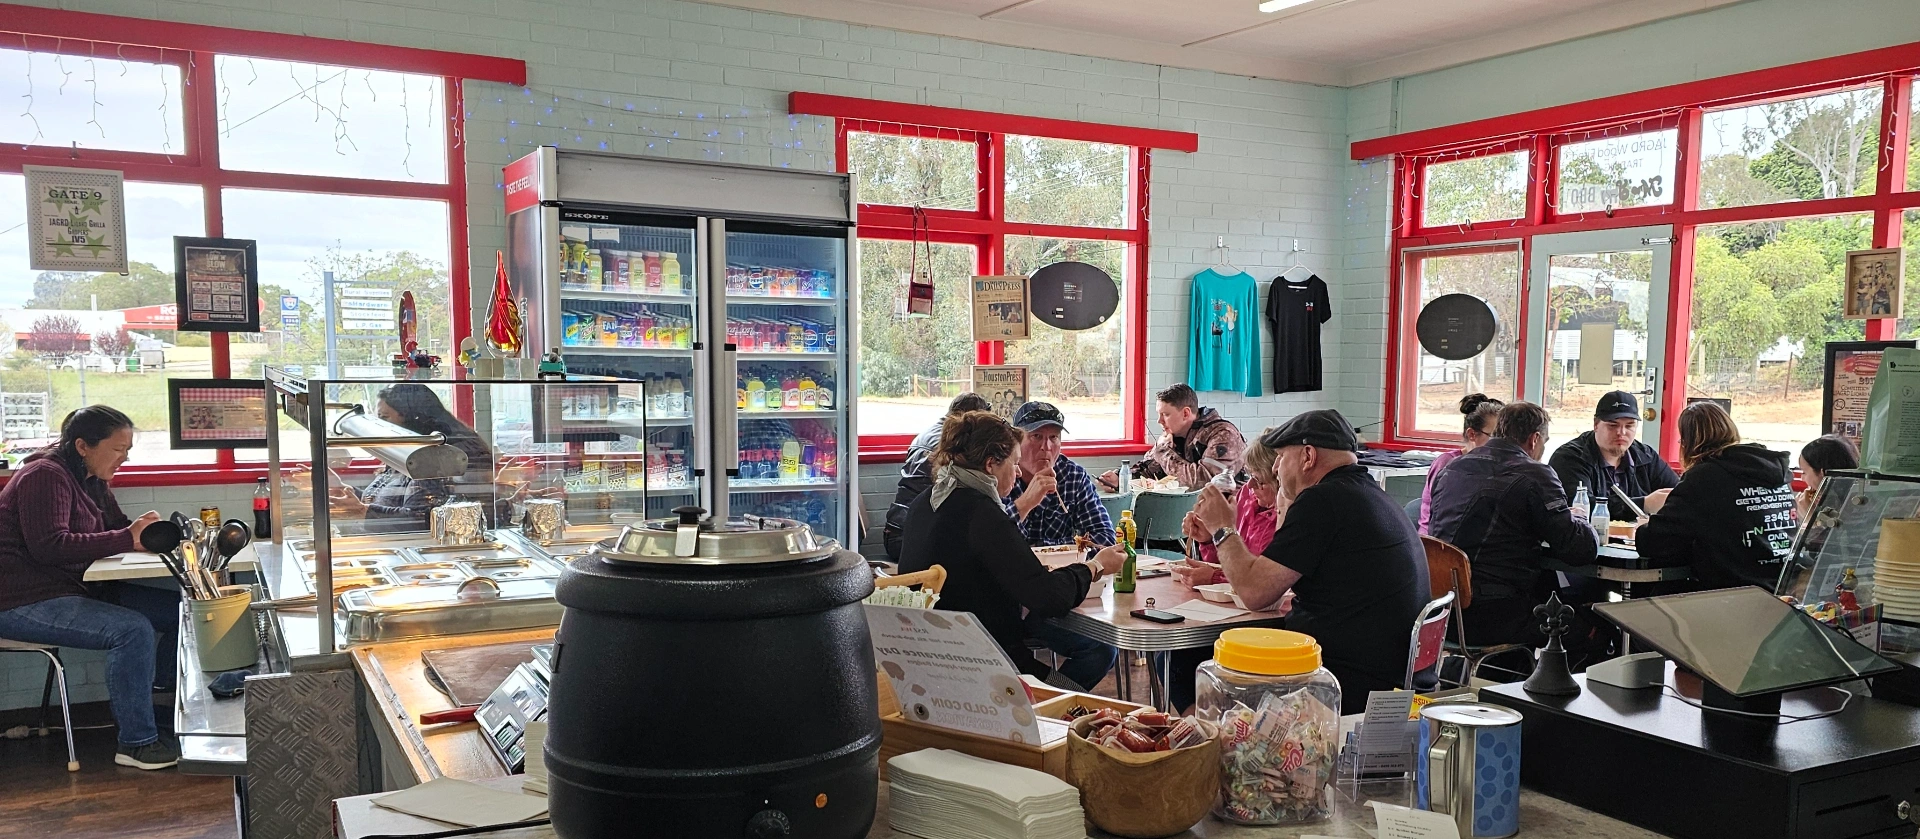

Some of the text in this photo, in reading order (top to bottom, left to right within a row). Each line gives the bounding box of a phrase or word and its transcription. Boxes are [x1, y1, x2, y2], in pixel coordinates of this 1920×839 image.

[48, 189, 102, 201] GATE 9
[564, 212, 609, 220] SKOPE
[49, 218, 69, 226] JAGRD
[206, 260, 226, 268] SLOW
[1740, 486, 1772, 497] WHEN
[1735, 493, 1795, 506] GETS YOU DOWN
[1746, 502, 1783, 512] REMEMBER
[1767, 532, 1788, 542] ONLY
[1770, 539, 1790, 550] ONE
